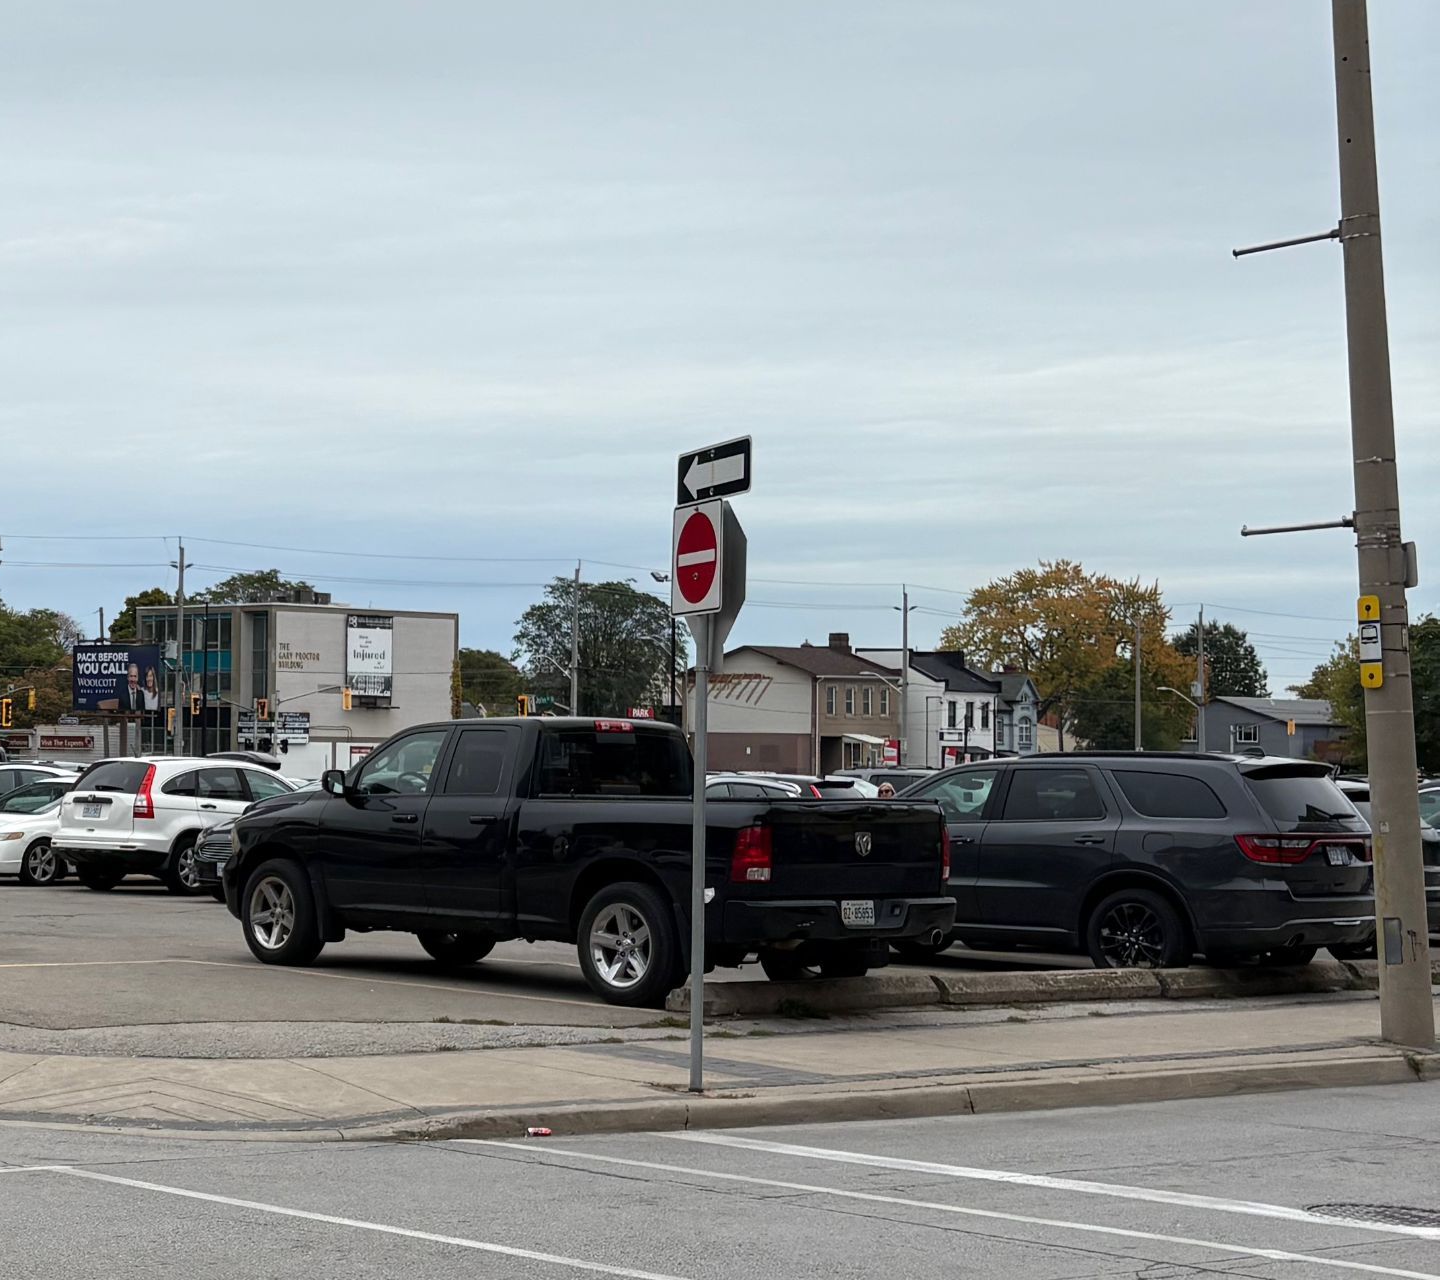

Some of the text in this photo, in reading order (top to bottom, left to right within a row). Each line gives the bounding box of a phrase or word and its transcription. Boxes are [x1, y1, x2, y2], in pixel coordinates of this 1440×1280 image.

[279, 643, 290, 651] THE
[77, 652, 129, 662] PACK BEFORE
[279, 652, 320, 661] GARY PROCTOR
[353, 649, 386, 661] Injured
[78, 663, 128, 674] YOU CALL
[279, 661, 304, 670] BUILDING
[78, 678, 117, 687] WOOLCOTT
[632, 708, 649, 718] PARK
[64, 739, 84, 748] Experts
